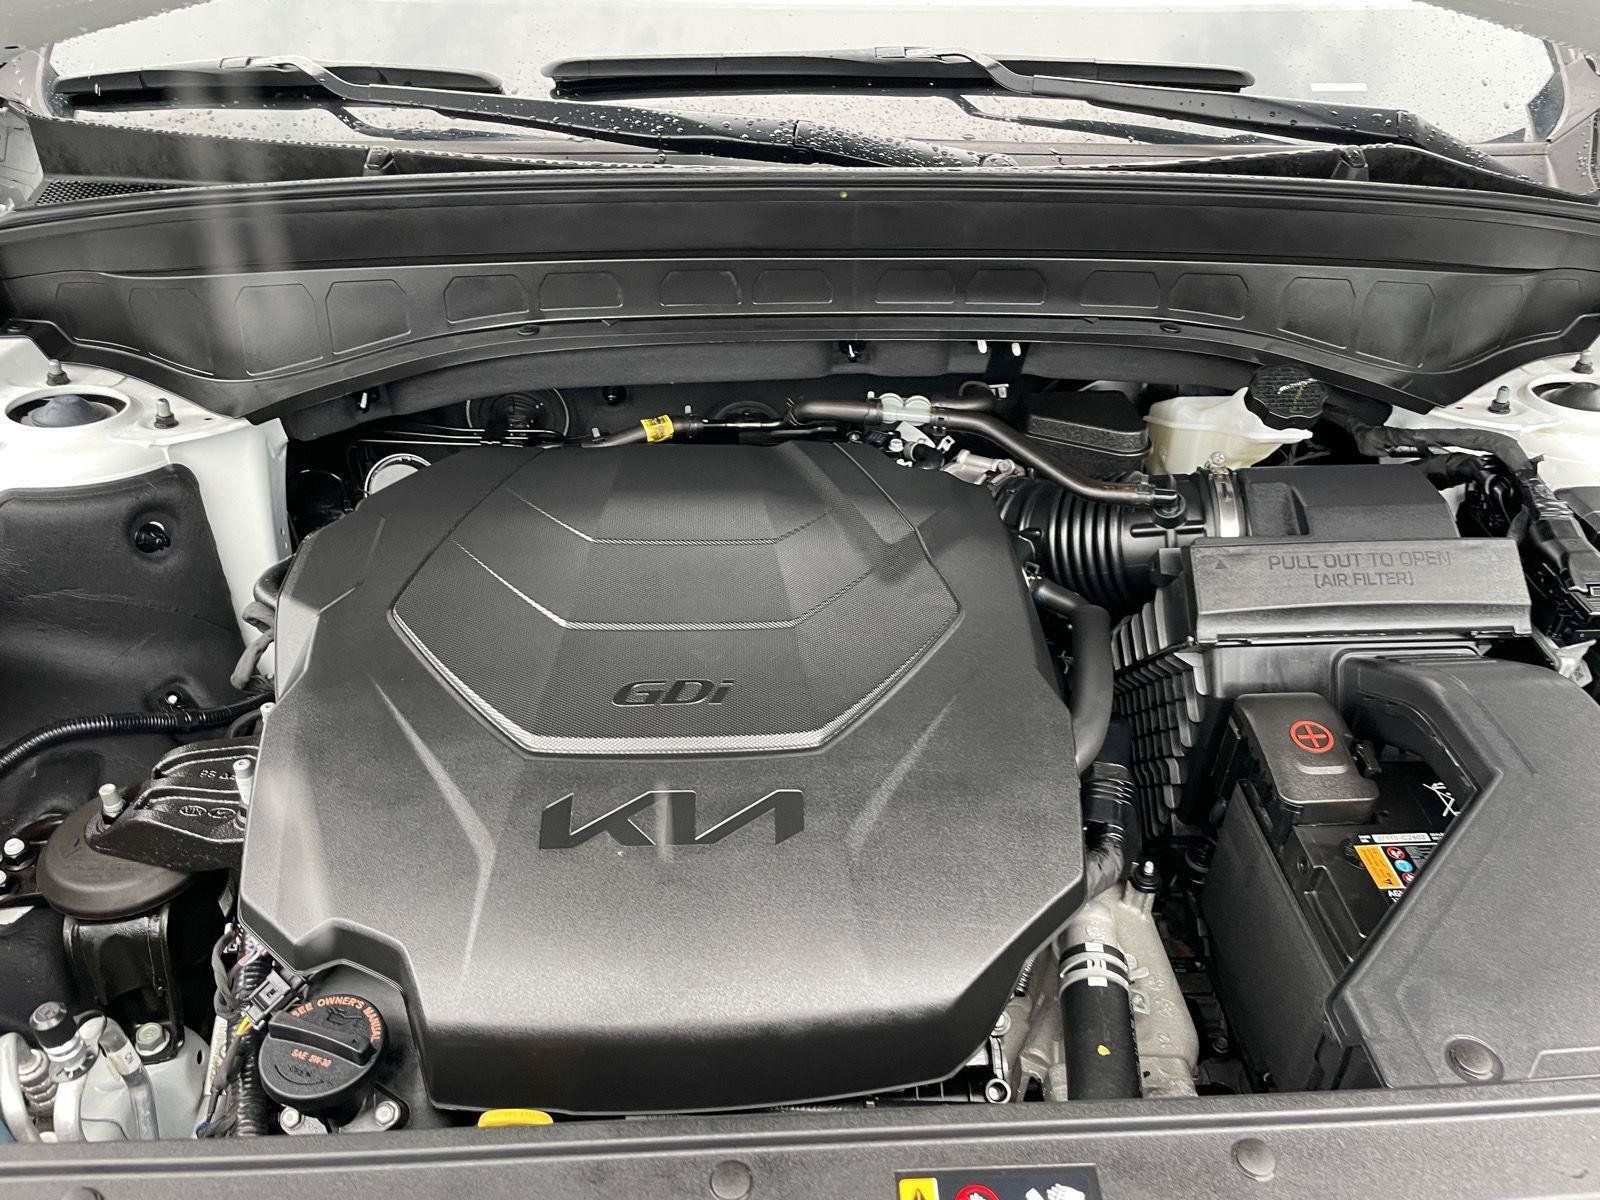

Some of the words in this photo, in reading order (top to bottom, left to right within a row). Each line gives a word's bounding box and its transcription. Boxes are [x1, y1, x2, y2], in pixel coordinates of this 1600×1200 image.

[1268, 554, 1319, 570] PULL
[1323, 553, 1363, 568] OUT
[1366, 551, 1394, 568] TO
[1399, 550, 1451, 567] OPEN
[539, 789, 805, 850] KIA
[291, 1002, 314, 1018] SEE
[317, 996, 365, 1009] OWNER'S
[362, 1006, 381, 1042] MANUAL
[291, 1049, 308, 1060] SAE
